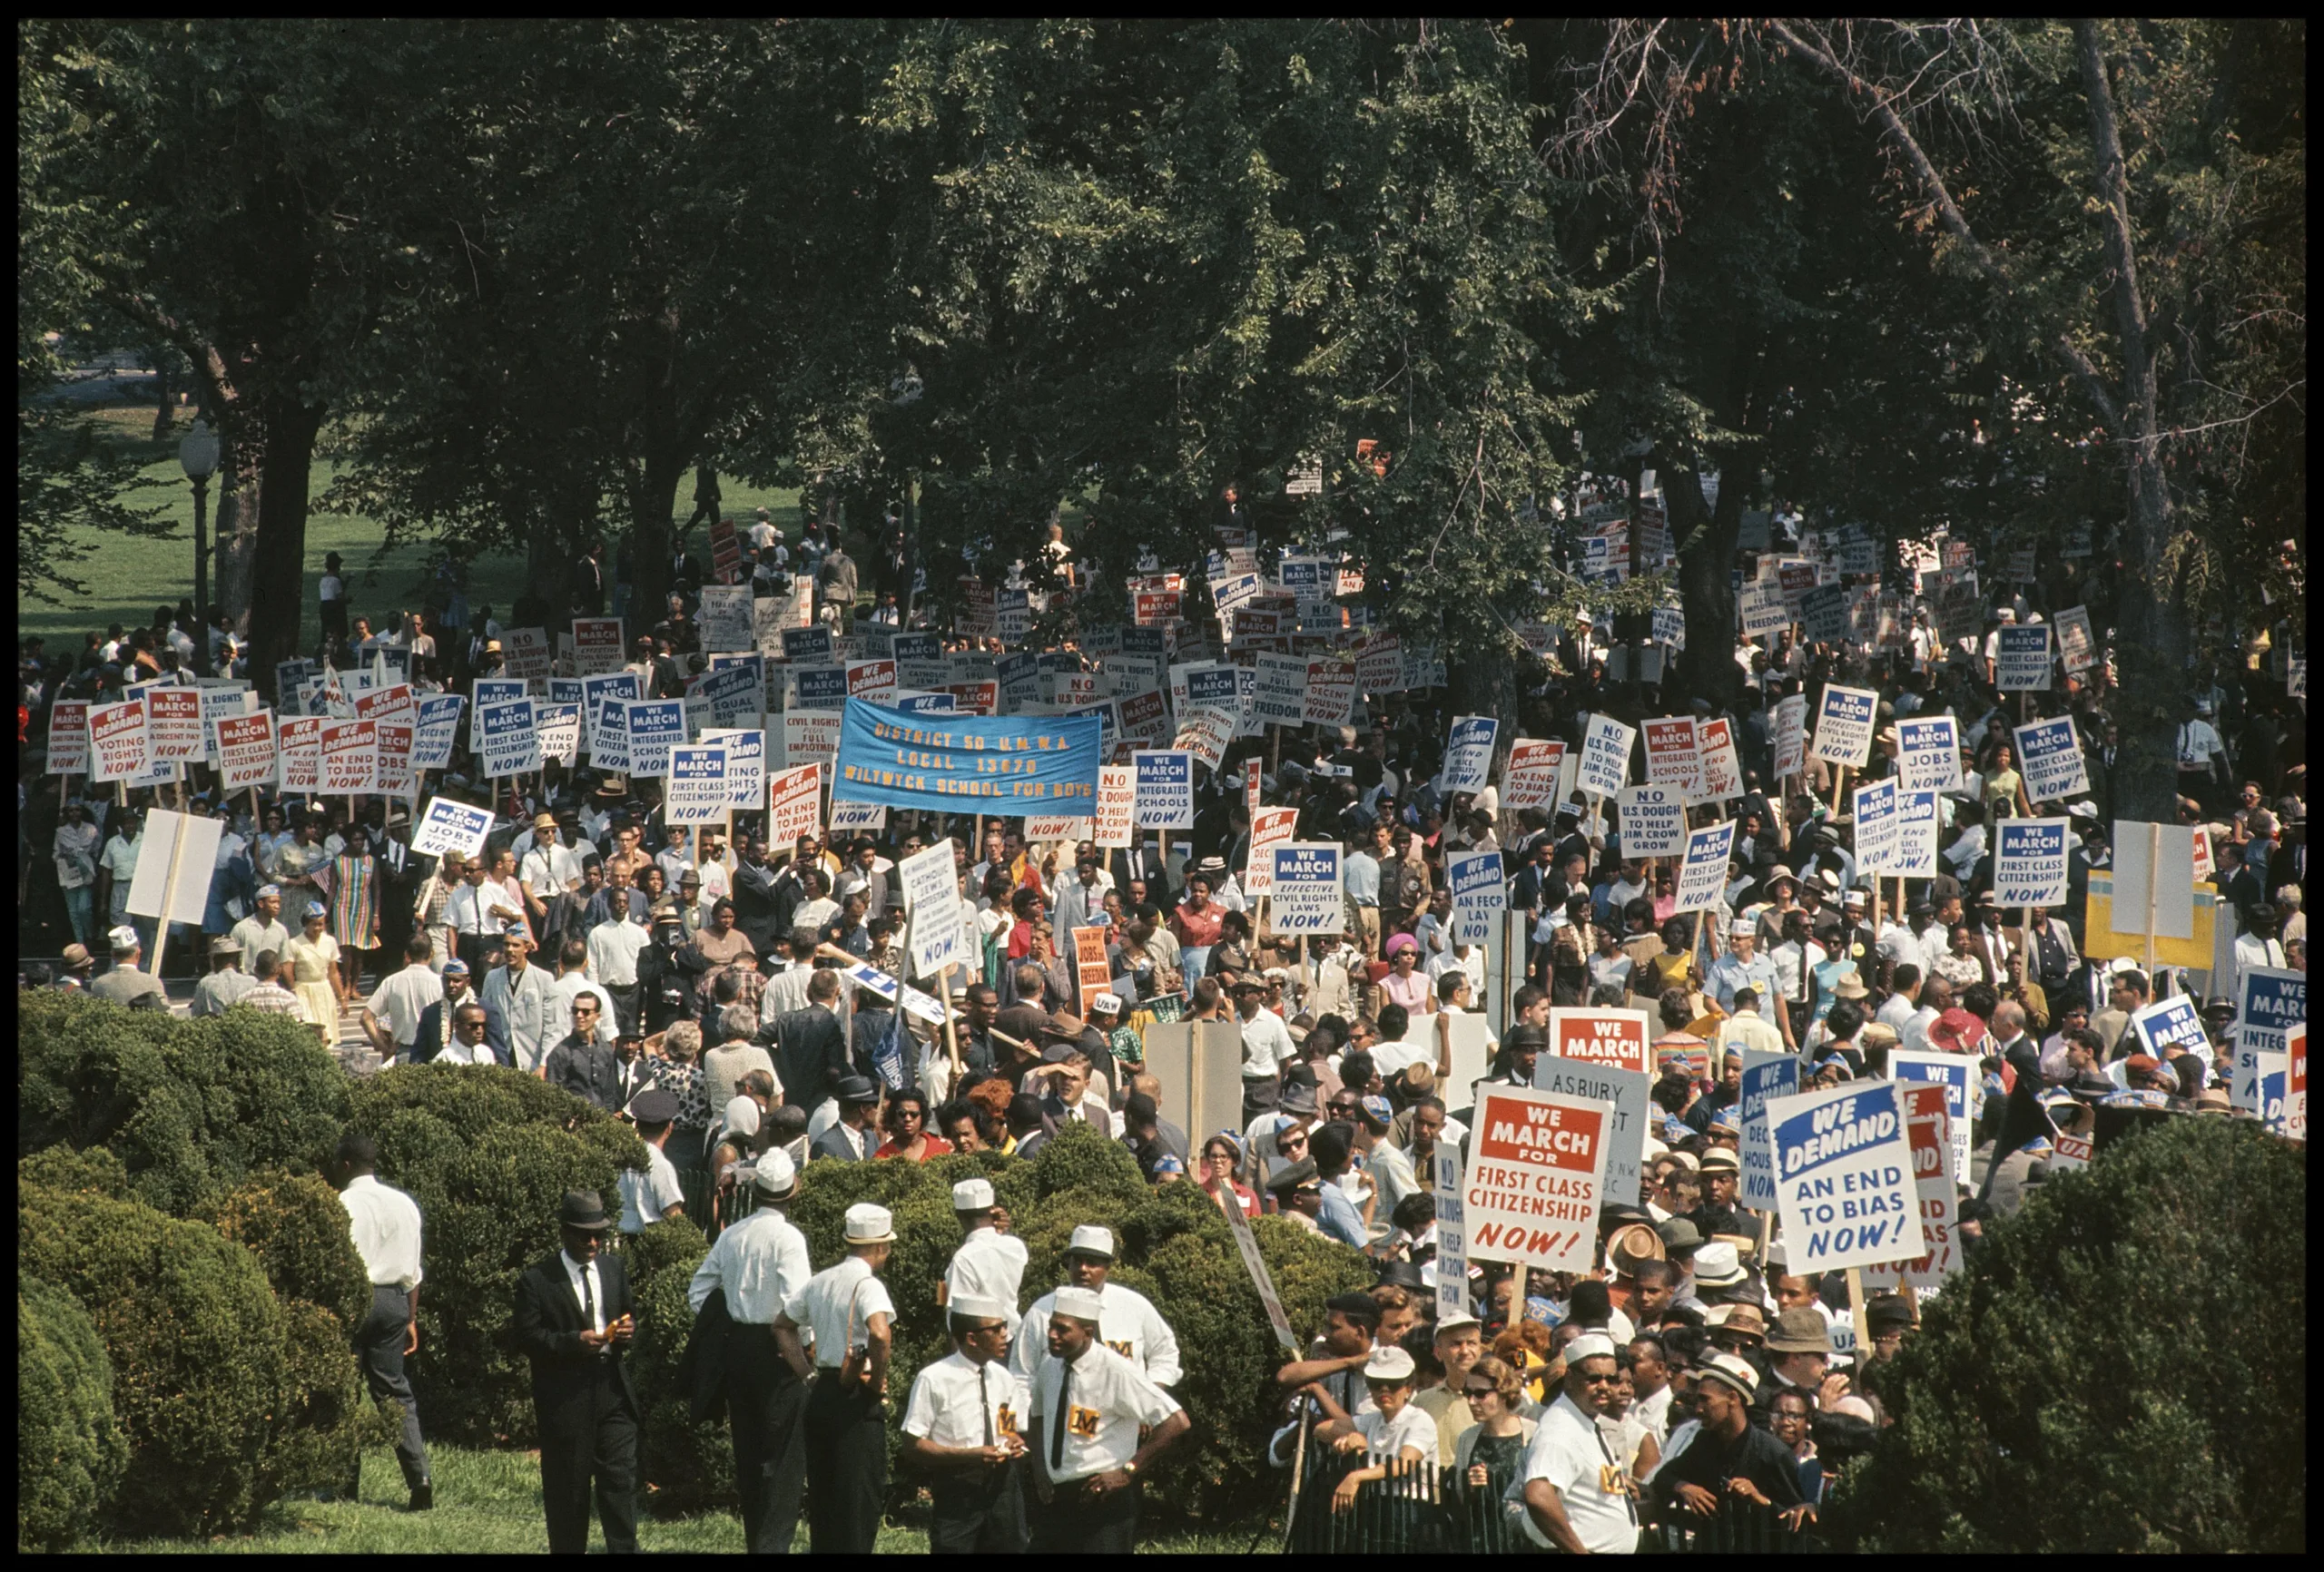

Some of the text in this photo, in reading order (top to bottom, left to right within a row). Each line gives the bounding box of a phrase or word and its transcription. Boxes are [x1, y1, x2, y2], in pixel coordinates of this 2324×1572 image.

[1747, 614, 1787, 629] FREEDOM
[789, 639, 825, 650] MARCH
[2004, 636, 2043, 645] MARCH
[1259, 659, 1306, 673] CIVIL RIGHTS
[1361, 657, 1396, 667] DECENT
[862, 663, 881, 677] WE
[852, 671, 893, 693] DEMAND
[1070, 679, 1095, 690] NO
[1192, 680, 1232, 692] MARCH
[2004, 674, 2044, 685] NOW!
[1256, 682, 1303, 696] EMPLOYMENT
[1311, 685, 1348, 700] DECENT
[153, 702, 195, 712] MARCH
[714, 697, 753, 711] EQUAL
[1255, 701, 1301, 718] FREEDOM
[1305, 697, 1350, 712] HOUSING
[1828, 701, 1869, 717] MARCH
[106, 707, 126, 722] WE
[420, 707, 457, 726] DEMAND
[487, 712, 529, 728] MARCH
[634, 712, 677, 725] MARCH
[1305, 707, 1346, 722] NOW!
[95, 714, 143, 739] DEMAND
[786, 718, 840, 727] CIVIL RIGHTS
[223, 723, 266, 740] MARCH
[419, 729, 450, 737] DECENT
[631, 733, 684, 744] INTEGRATED
[874, 722, 951, 747] DISTRICT
[1602, 724, 1623, 739] NO
[1651, 732, 1691, 744] MARCH
[1905, 731, 1950, 744] MARCH
[97, 736, 145, 750] VOTING
[324, 731, 374, 752] DEMAND
[414, 741, 450, 749] HOUSING
[486, 731, 535, 747] FIRST CLASS
[2025, 732, 2070, 752] MARCH
[103, 748, 144, 761] RIGHTS
[154, 744, 199, 756] NOW!
[222, 743, 274, 759] FIRST CLASS
[485, 741, 537, 757] CITIZENSHIP
[1819, 744, 1862, 761] NOW!
[51, 755, 83, 768] NOW!
[222, 752, 276, 768] CITIZENSHIP
[327, 755, 373, 764] AN END
[413, 751, 448, 762] NOW!
[492, 753, 534, 771] NOW!
[692, 752, 708, 761] WE
[897, 750, 1036, 773] LOCAL 13670
[1512, 752, 1561, 770] DEMAND
[1650, 752, 1698, 763] INTEGRATED
[1908, 752, 1951, 766] JOBS
[2026, 752, 2077, 771] FIRST CLASS
[103, 758, 146, 775] NOW!
[350, 766, 373, 774] BIAS
[676, 761, 722, 771] MARCH
[1140, 766, 1184, 775] MARCH
[1652, 764, 1699, 775] SCHOOLS
[2026, 761, 2081, 781] CITIZENSHIP
[231, 765, 273, 782] NOW!
[1103, 774, 1126, 786] NO
[1512, 772, 1555, 782] AN END
[327, 775, 372, 788] NOW!
[673, 782, 724, 791] FIRST CLASS
[845, 765, 1091, 797] WILTWYCK SCHOOL FOR BOYS
[1511, 781, 1551, 792] TO BIAS
[1911, 774, 1955, 789] NOW!
[2036, 774, 2080, 797] NOW!
[670, 792, 725, 801] CITIZENSHIP
[774, 776, 816, 804] DEMAND
[1107, 791, 1133, 802] DOUGH
[1137, 786, 1187, 795] INTEGRATED
[1636, 791, 1665, 801] NO
[1137, 799, 1187, 807] SCHOOLS
[1506, 792, 1550, 804] NOW!
[674, 806, 720, 819] NOW!
[776, 801, 816, 818] AN END
[834, 810, 880, 823] NOW!
[1622, 805, 1680, 816] U.S. DOUGH
[777, 813, 815, 830] TO BIAS
[1107, 818, 1130, 827] CROW
[1140, 811, 1186, 823] NOW!
[1629, 820, 1674, 829] TO HELP
[428, 825, 474, 843] JOBS
[1623, 829, 1679, 839] JIM CROW
[2024, 827, 2043, 837] WE
[1633, 840, 1669, 850] GROW
[2005, 836, 2060, 849] MARCH
[1296, 850, 1315, 860] WE
[1863, 844, 1896, 867] NOW!
[1279, 860, 1333, 873] MARCH
[1466, 858, 1484, 873] WE
[2001, 860, 2063, 871] FIRST CLASS
[1456, 867, 1500, 891] DEMAND
[1998, 871, 2063, 882] CITIZENSHIP
[920, 881, 943, 897] JEWS
[1280, 884, 1334, 893] EFFECTIVE
[1683, 884, 1720, 904] NOW!
[2004, 886, 2057, 901] NOW!
[1273, 894, 1339, 902] CIVIL RIGHTS
[1458, 895, 1502, 908] AN FECP
[1290, 904, 1320, 912] LAWS
[1279, 912, 1334, 928] NOW!
[924, 928, 960, 966] NOW!
[1098, 999, 1118, 1009] UAW
[1594, 1022, 1621, 1037] WE
[1566, 1037, 1640, 1059] MARCH
[1926, 1065, 1950, 1082] WE
[1552, 1074, 1624, 1102] ASBURY
[1527, 1105, 1561, 1125] WE
[1813, 1096, 1857, 1135] WE
[1490, 1122, 1590, 1155] MARCH
[1785, 1111, 1896, 1174] DEMAND
[1519, 1148, 1558, 1164] FOR
[1476, 1165, 1592, 1200] FIRST CLASS
[1797, 1165, 1902, 1202] AN END
[1469, 1189, 1592, 1223] CITIZENSHIP
[1799, 1192, 1905, 1226] TO BIAS
[1474, 1223, 1581, 1258] NOW!
[1807, 1213, 1905, 1259] NOW!
[1107, 1341, 1133, 1357] M
[1073, 1409, 1099, 1434] M
